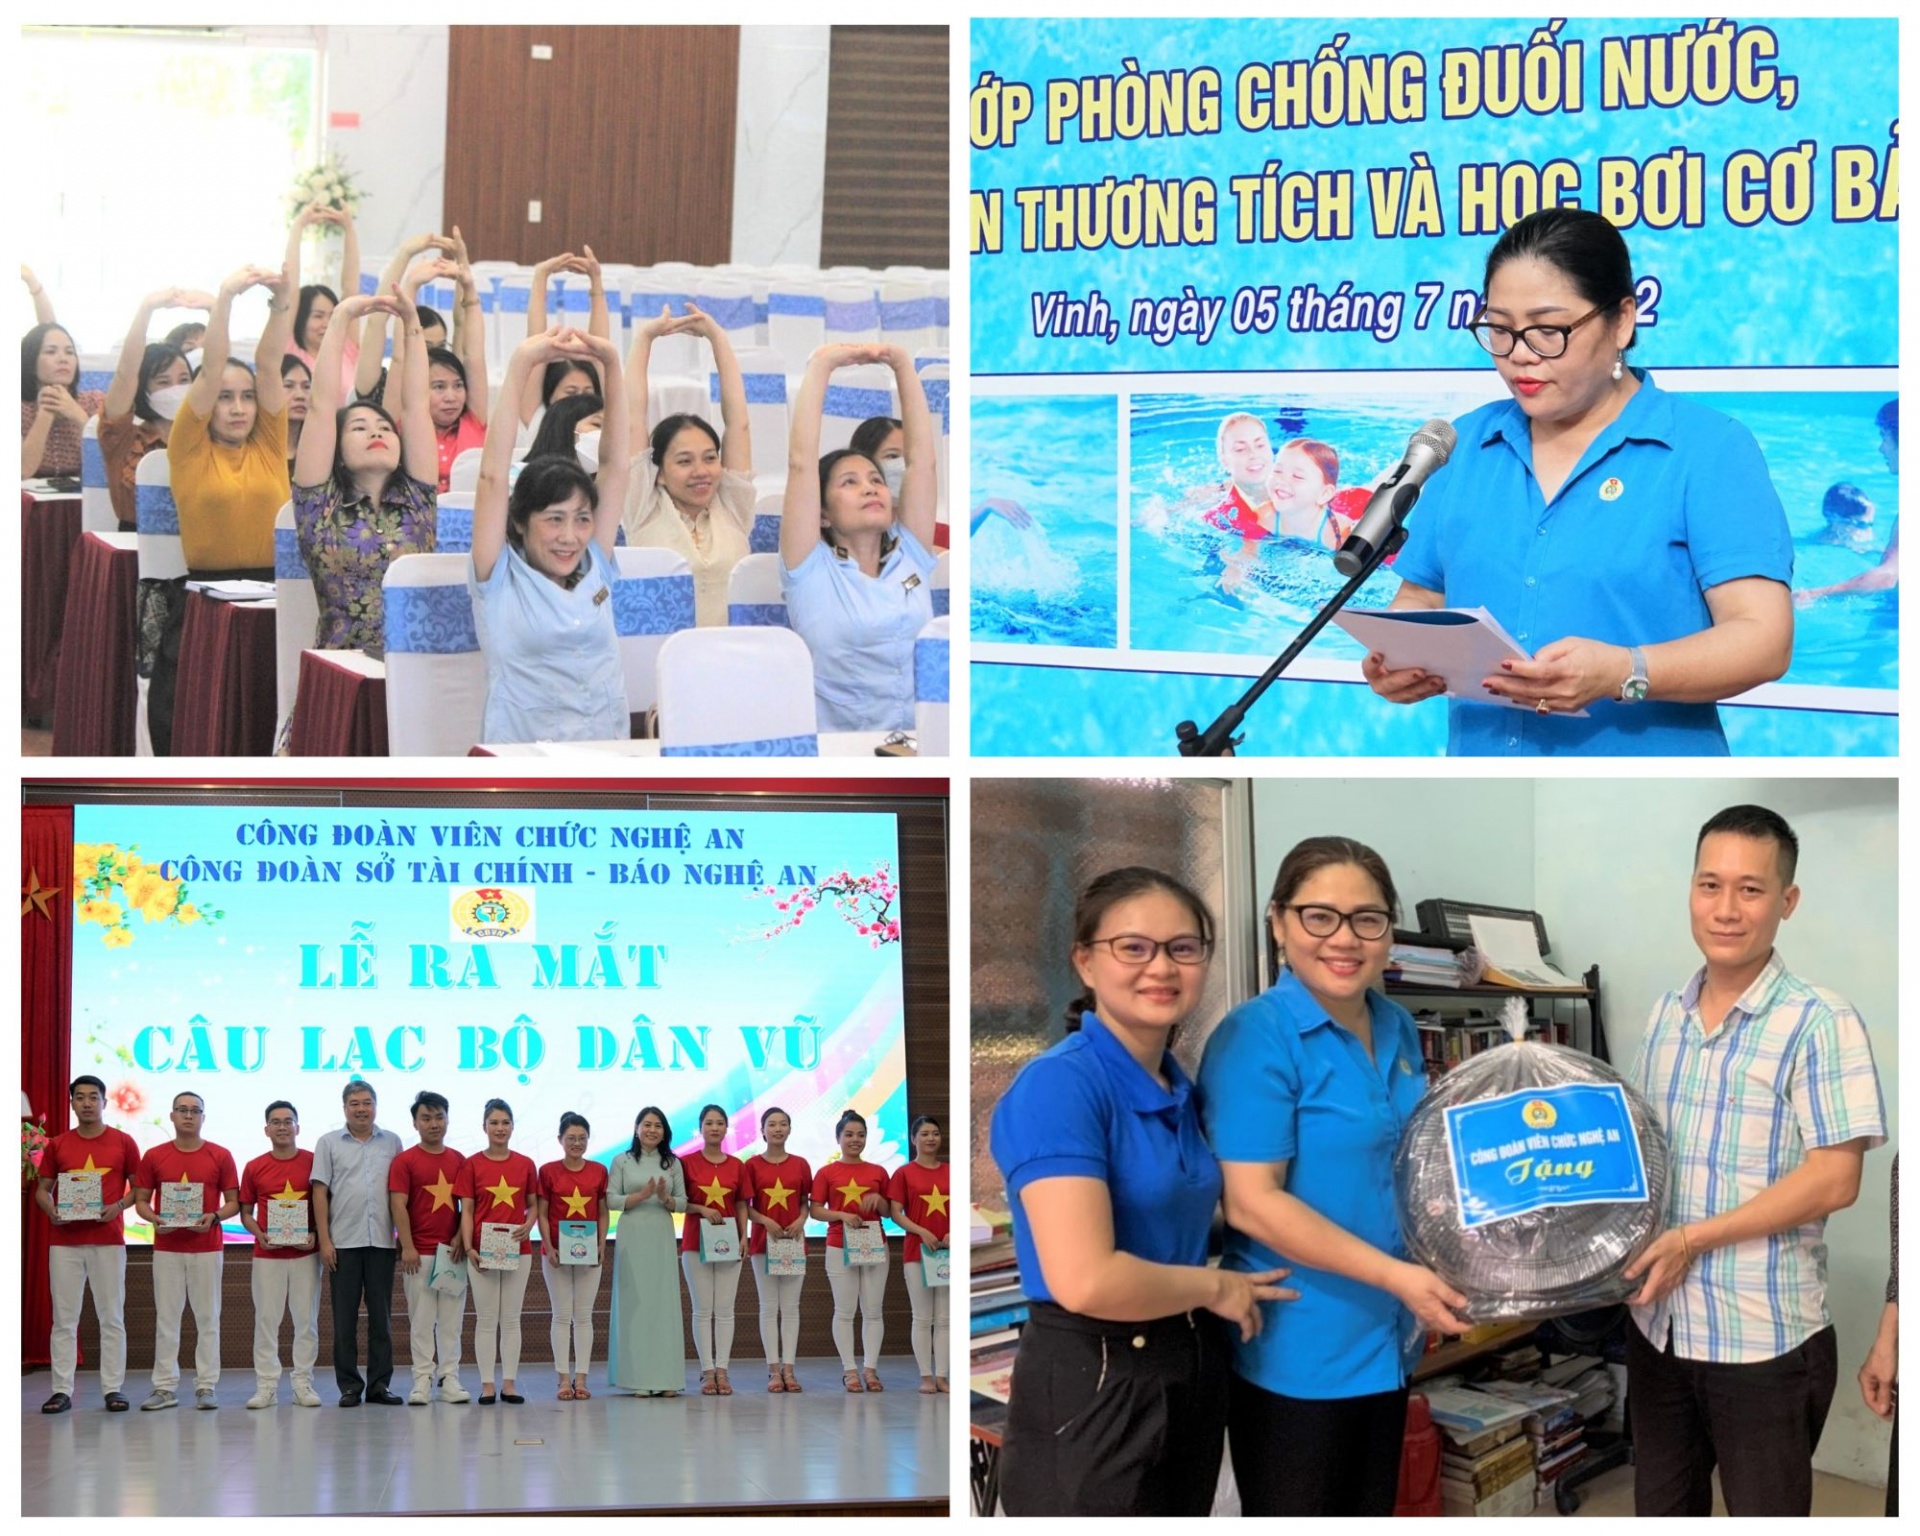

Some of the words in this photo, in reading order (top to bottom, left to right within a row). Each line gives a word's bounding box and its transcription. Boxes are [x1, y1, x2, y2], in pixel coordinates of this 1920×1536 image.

[970, 71, 1034, 150] ỚP
[1046, 57, 1221, 144] PHÒNG
[1236, 33, 1426, 131] CHỐNG
[1439, 18, 1584, 119] ĐUỐI
[1600, 18, 1798, 110] NƯỚC,
[970, 189, 1003, 254] N
[1015, 174, 1217, 253] THƯƠNG
[1231, 159, 1353, 243] TÍCH
[1367, 152, 1445, 238] VÀ
[1598, 146, 1706, 229] BƠI
[1723, 140, 1816, 228] CƠ
[1031, 289, 1120, 342] Vinh,
[1129, 286, 1225, 345] ngày
[1231, 286, 1280, 334] 05
[1288, 281, 1403, 342] tháng
[1414, 281, 1443, 329] 7
[236, 818, 318, 846] CÔNG
[332, 819, 416, 846] ĐOÀN
[430, 820, 502, 847] VIÊN
[515, 821, 597, 848] CHỨC
[611, 822, 691, 855] NGHỆ
[704, 828, 745, 849] AN
[160, 854, 242, 882] CÔNG
[256, 855, 342, 882] ĐOÀN
[356, 851, 396, 883] SỞ
[407, 855, 460, 883] TÀI
[474, 857, 573, 884] CHÍNH
[609, 857, 671, 884] BÁO
[684, 859, 764, 891] NGHỆ
[777, 864, 817, 886] AN
[299, 920, 377, 988] LỄ
[409, 943, 499, 989] RA
[532, 920, 667, 989] MẮT
[132, 1013, 269, 1072] CÂU
[300, 1024, 425, 1082] LẠC
[457, 1014, 545, 1085] BỘ
[577, 1013, 709, 1072] DÂN
[739, 1014, 824, 1072] VŨ
[1471, 1147, 1497, 1165] CÔNG
[1527, 1133, 1549, 1150] VIÊN
[1607, 1128, 1620, 1142] AN
[1505, 1157, 1595, 1185] Tặng
